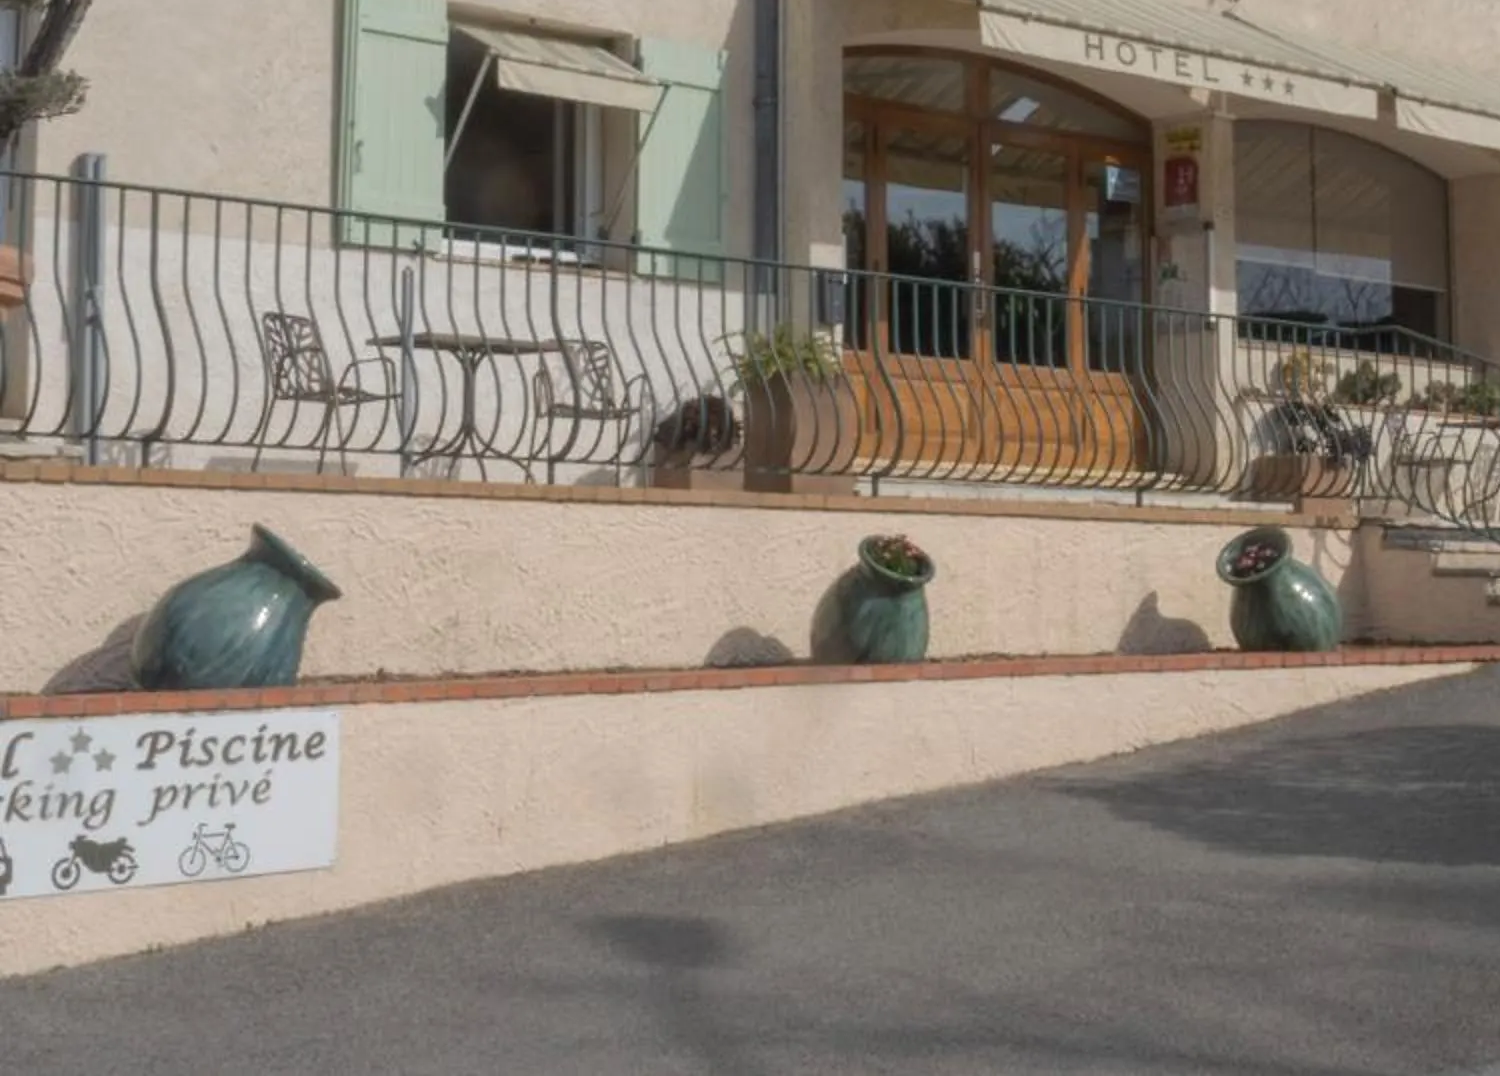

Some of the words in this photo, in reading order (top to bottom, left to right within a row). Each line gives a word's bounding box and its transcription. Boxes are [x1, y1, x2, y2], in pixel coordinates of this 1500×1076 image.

[1084, 33, 1221, 84] HOTEL
[135, 724, 327, 771] Piscine
[0, 779, 118, 832] king
[135, 768, 275, 827] privé
